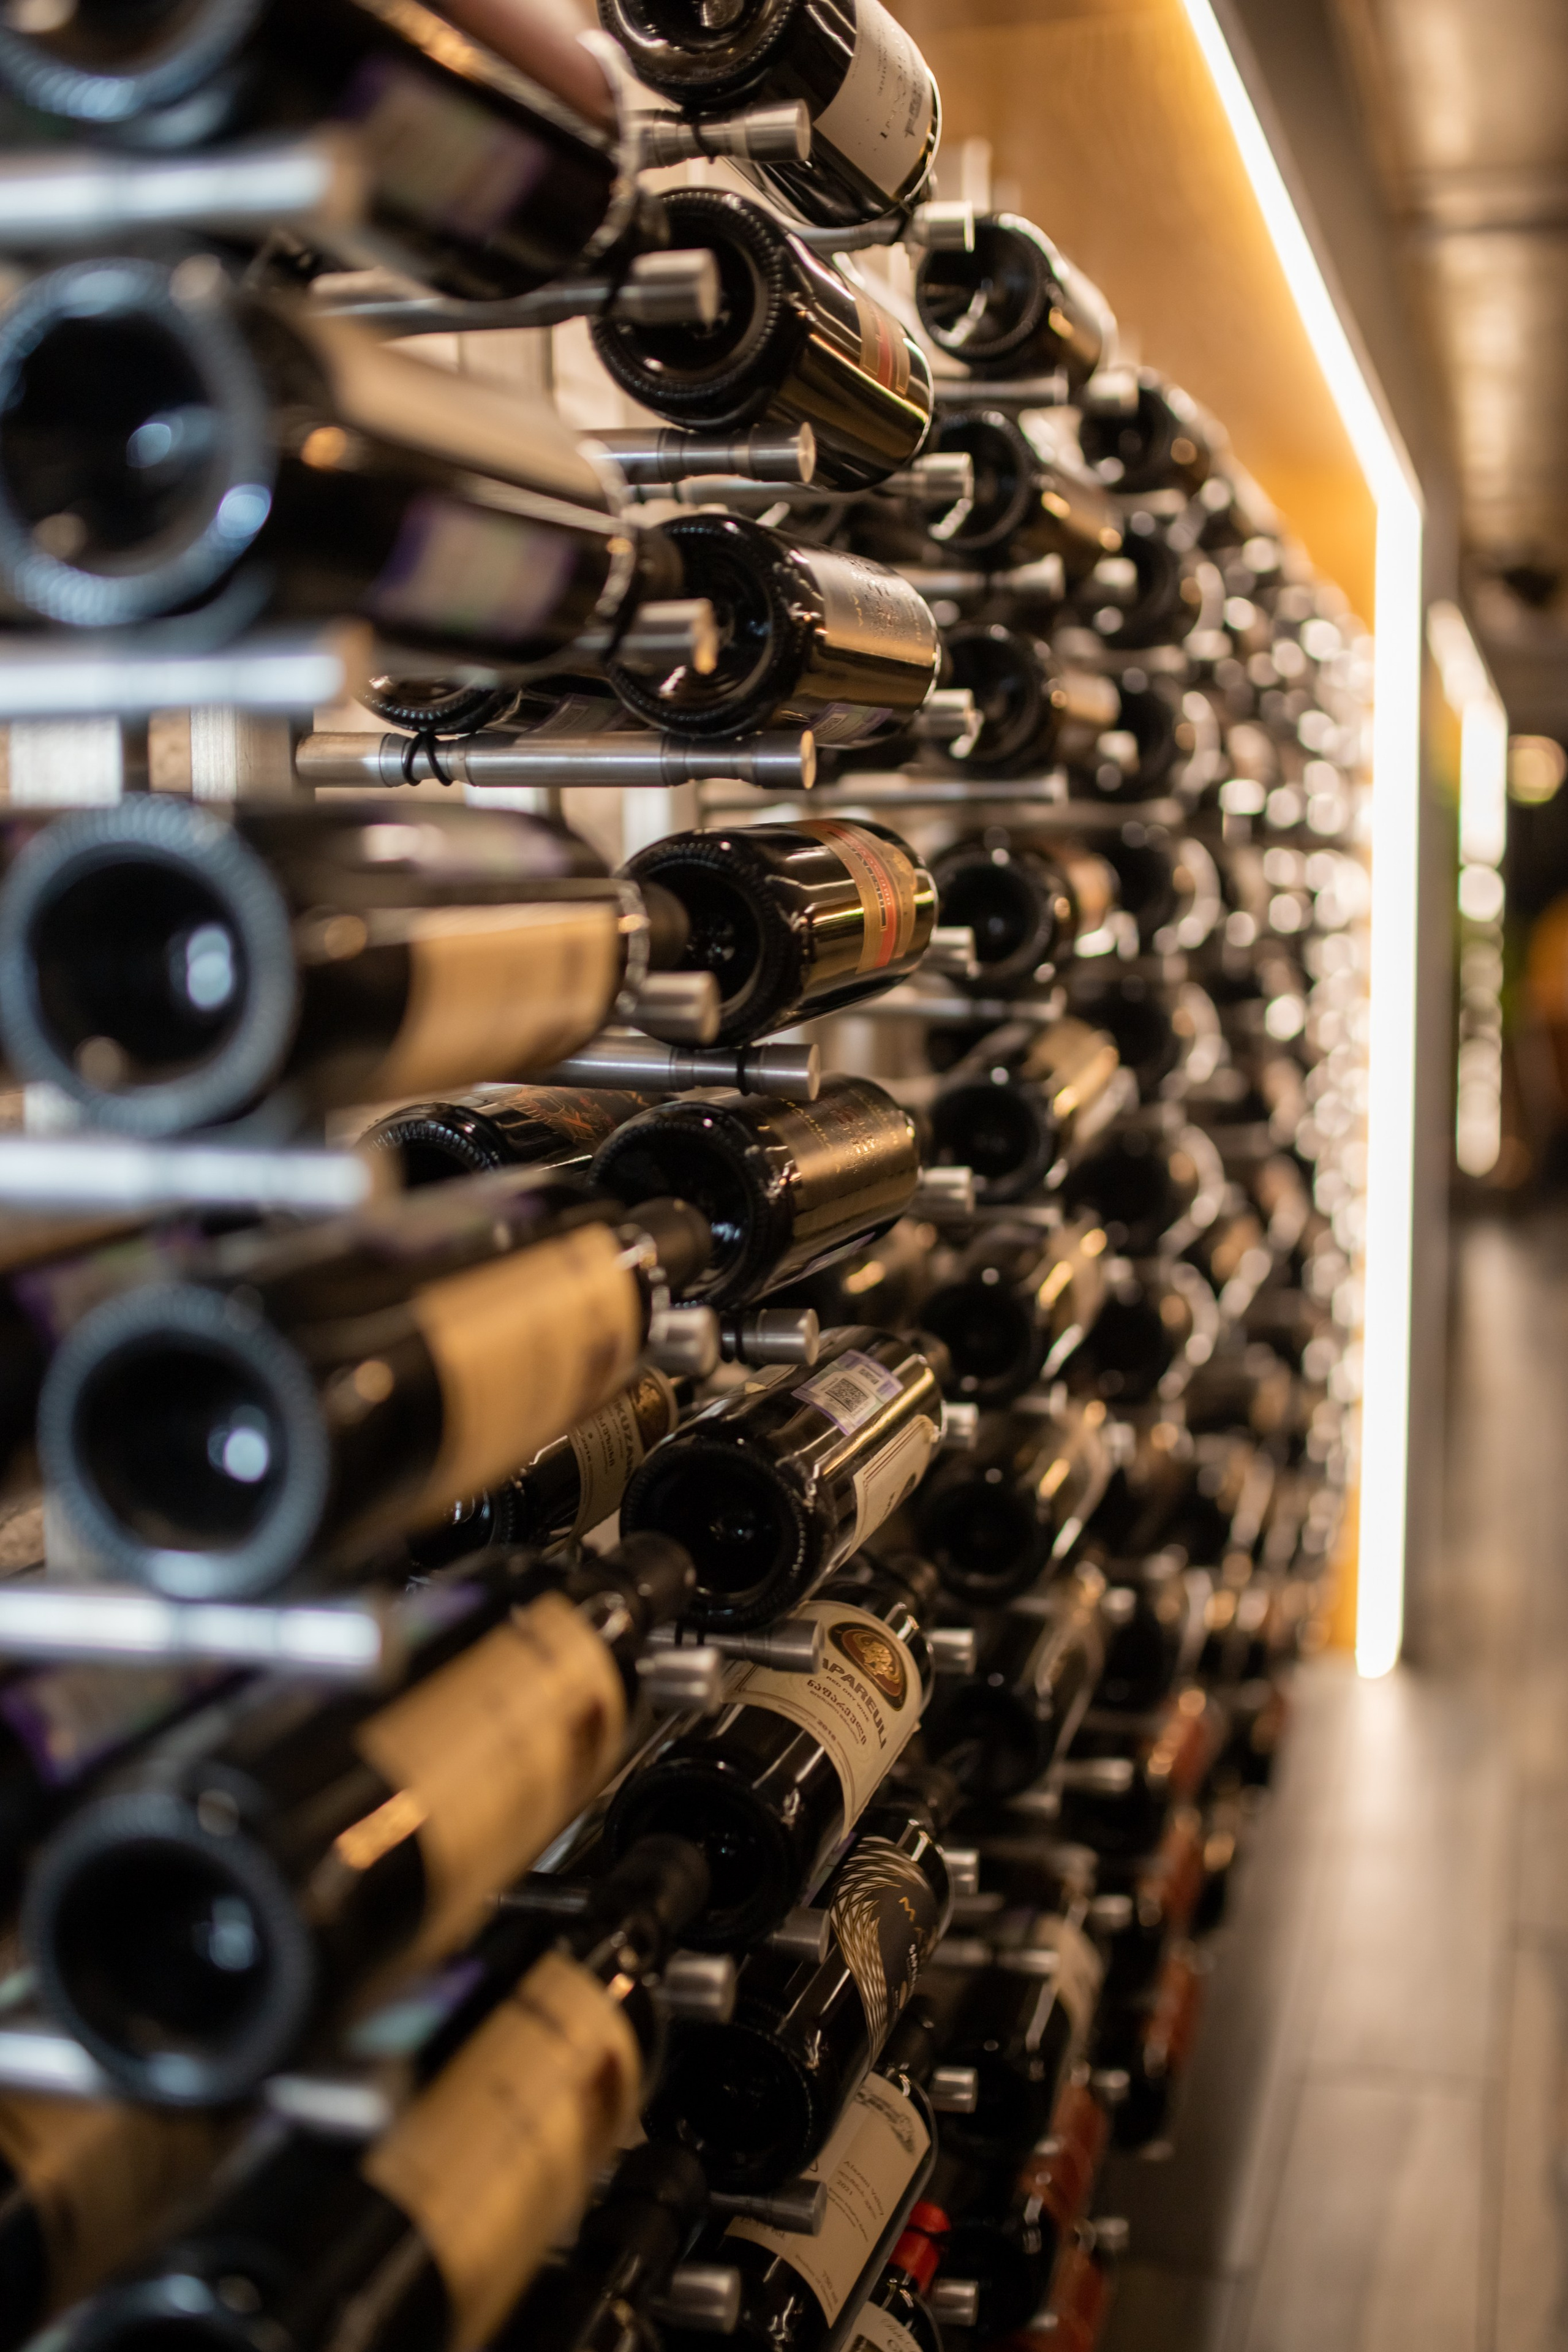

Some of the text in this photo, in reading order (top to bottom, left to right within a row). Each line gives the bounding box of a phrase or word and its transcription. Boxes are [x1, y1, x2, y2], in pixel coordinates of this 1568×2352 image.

[822, 1657, 888, 1750] APAREULI
[826, 1675, 870, 1723] RED DRY WINE
[837, 2179, 853, 2196] 2021
